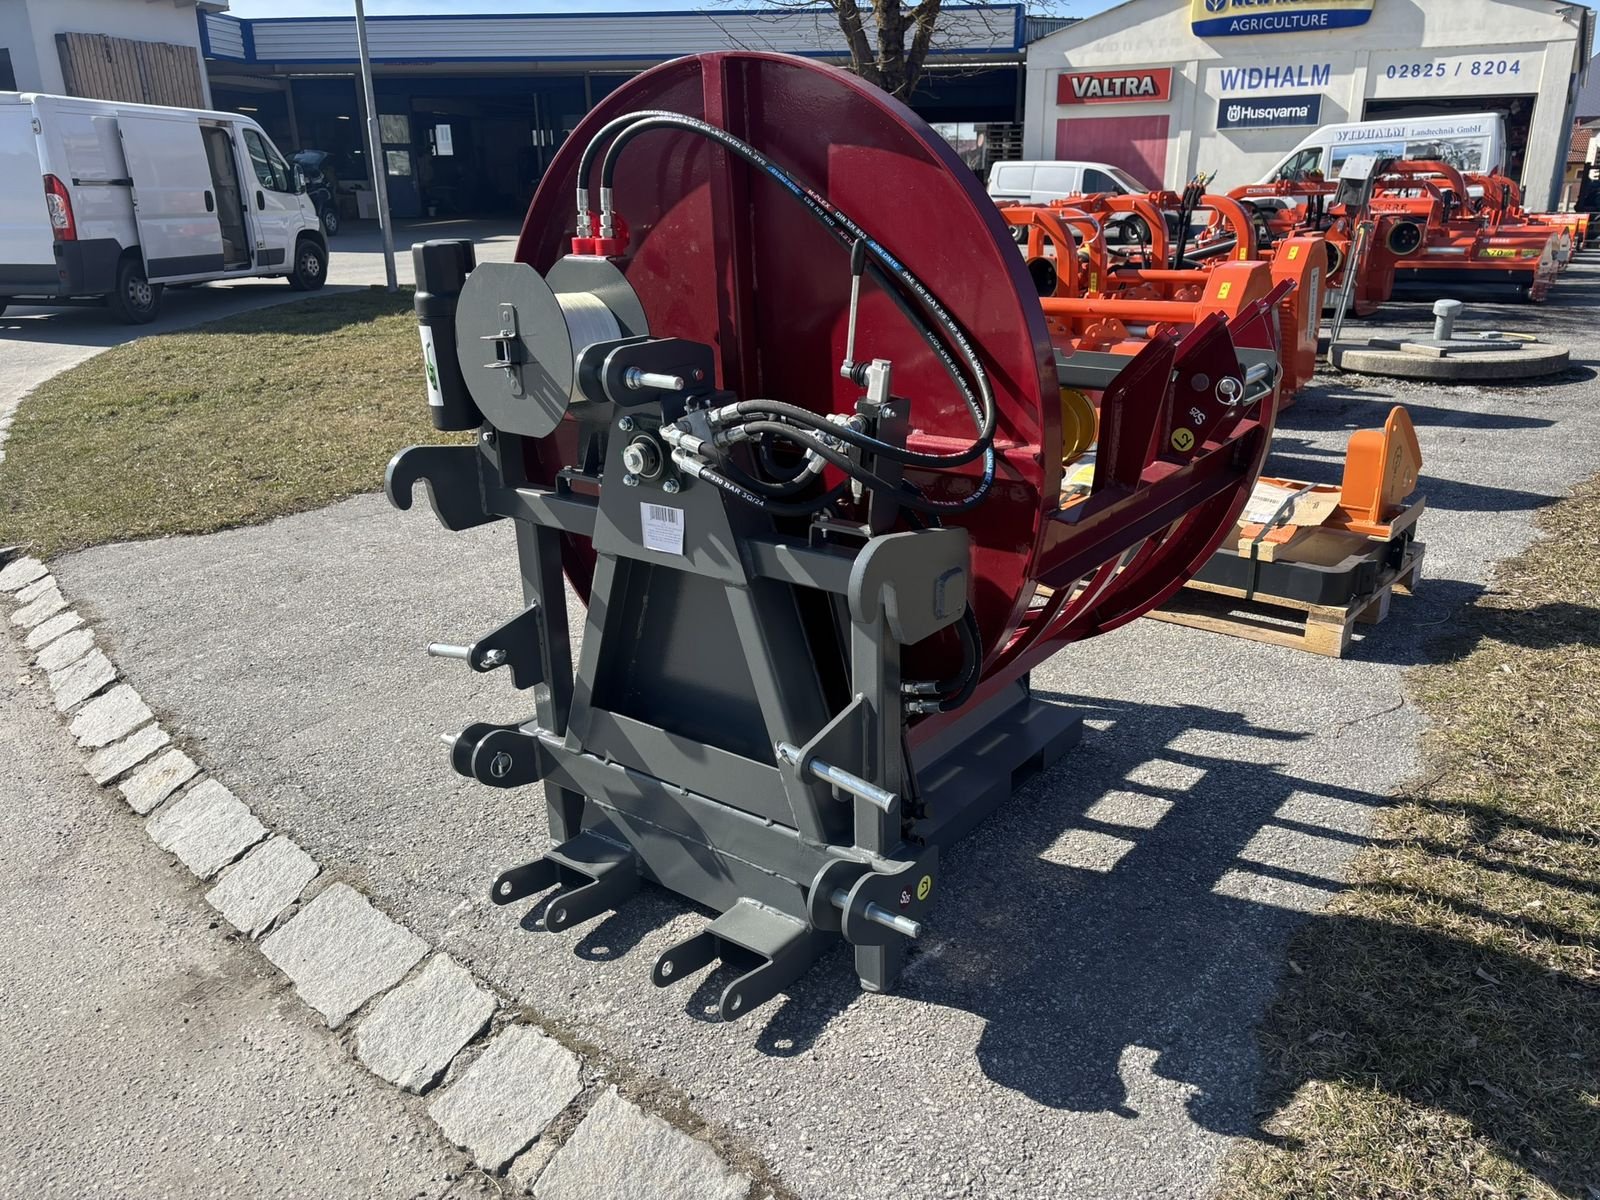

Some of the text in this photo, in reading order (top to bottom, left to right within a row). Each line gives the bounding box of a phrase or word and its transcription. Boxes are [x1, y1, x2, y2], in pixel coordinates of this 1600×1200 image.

[1229, 13, 1329, 32] AGRICULTURE
[1220, 63, 1331, 91] WIDHALM
[1386, 60, 1521, 79] 02825 / 8204
[1071, 76, 1155, 98] VALTRA
[1241, 104, 1309, 120] Husqvarna
[1336, 124, 1482, 141] WIDHALM Landtechnik GmbH
[1173, 433, 1193, 449] L2
[710, 474, 724, 485] 330
[723, 481, 741, 495] BAR
